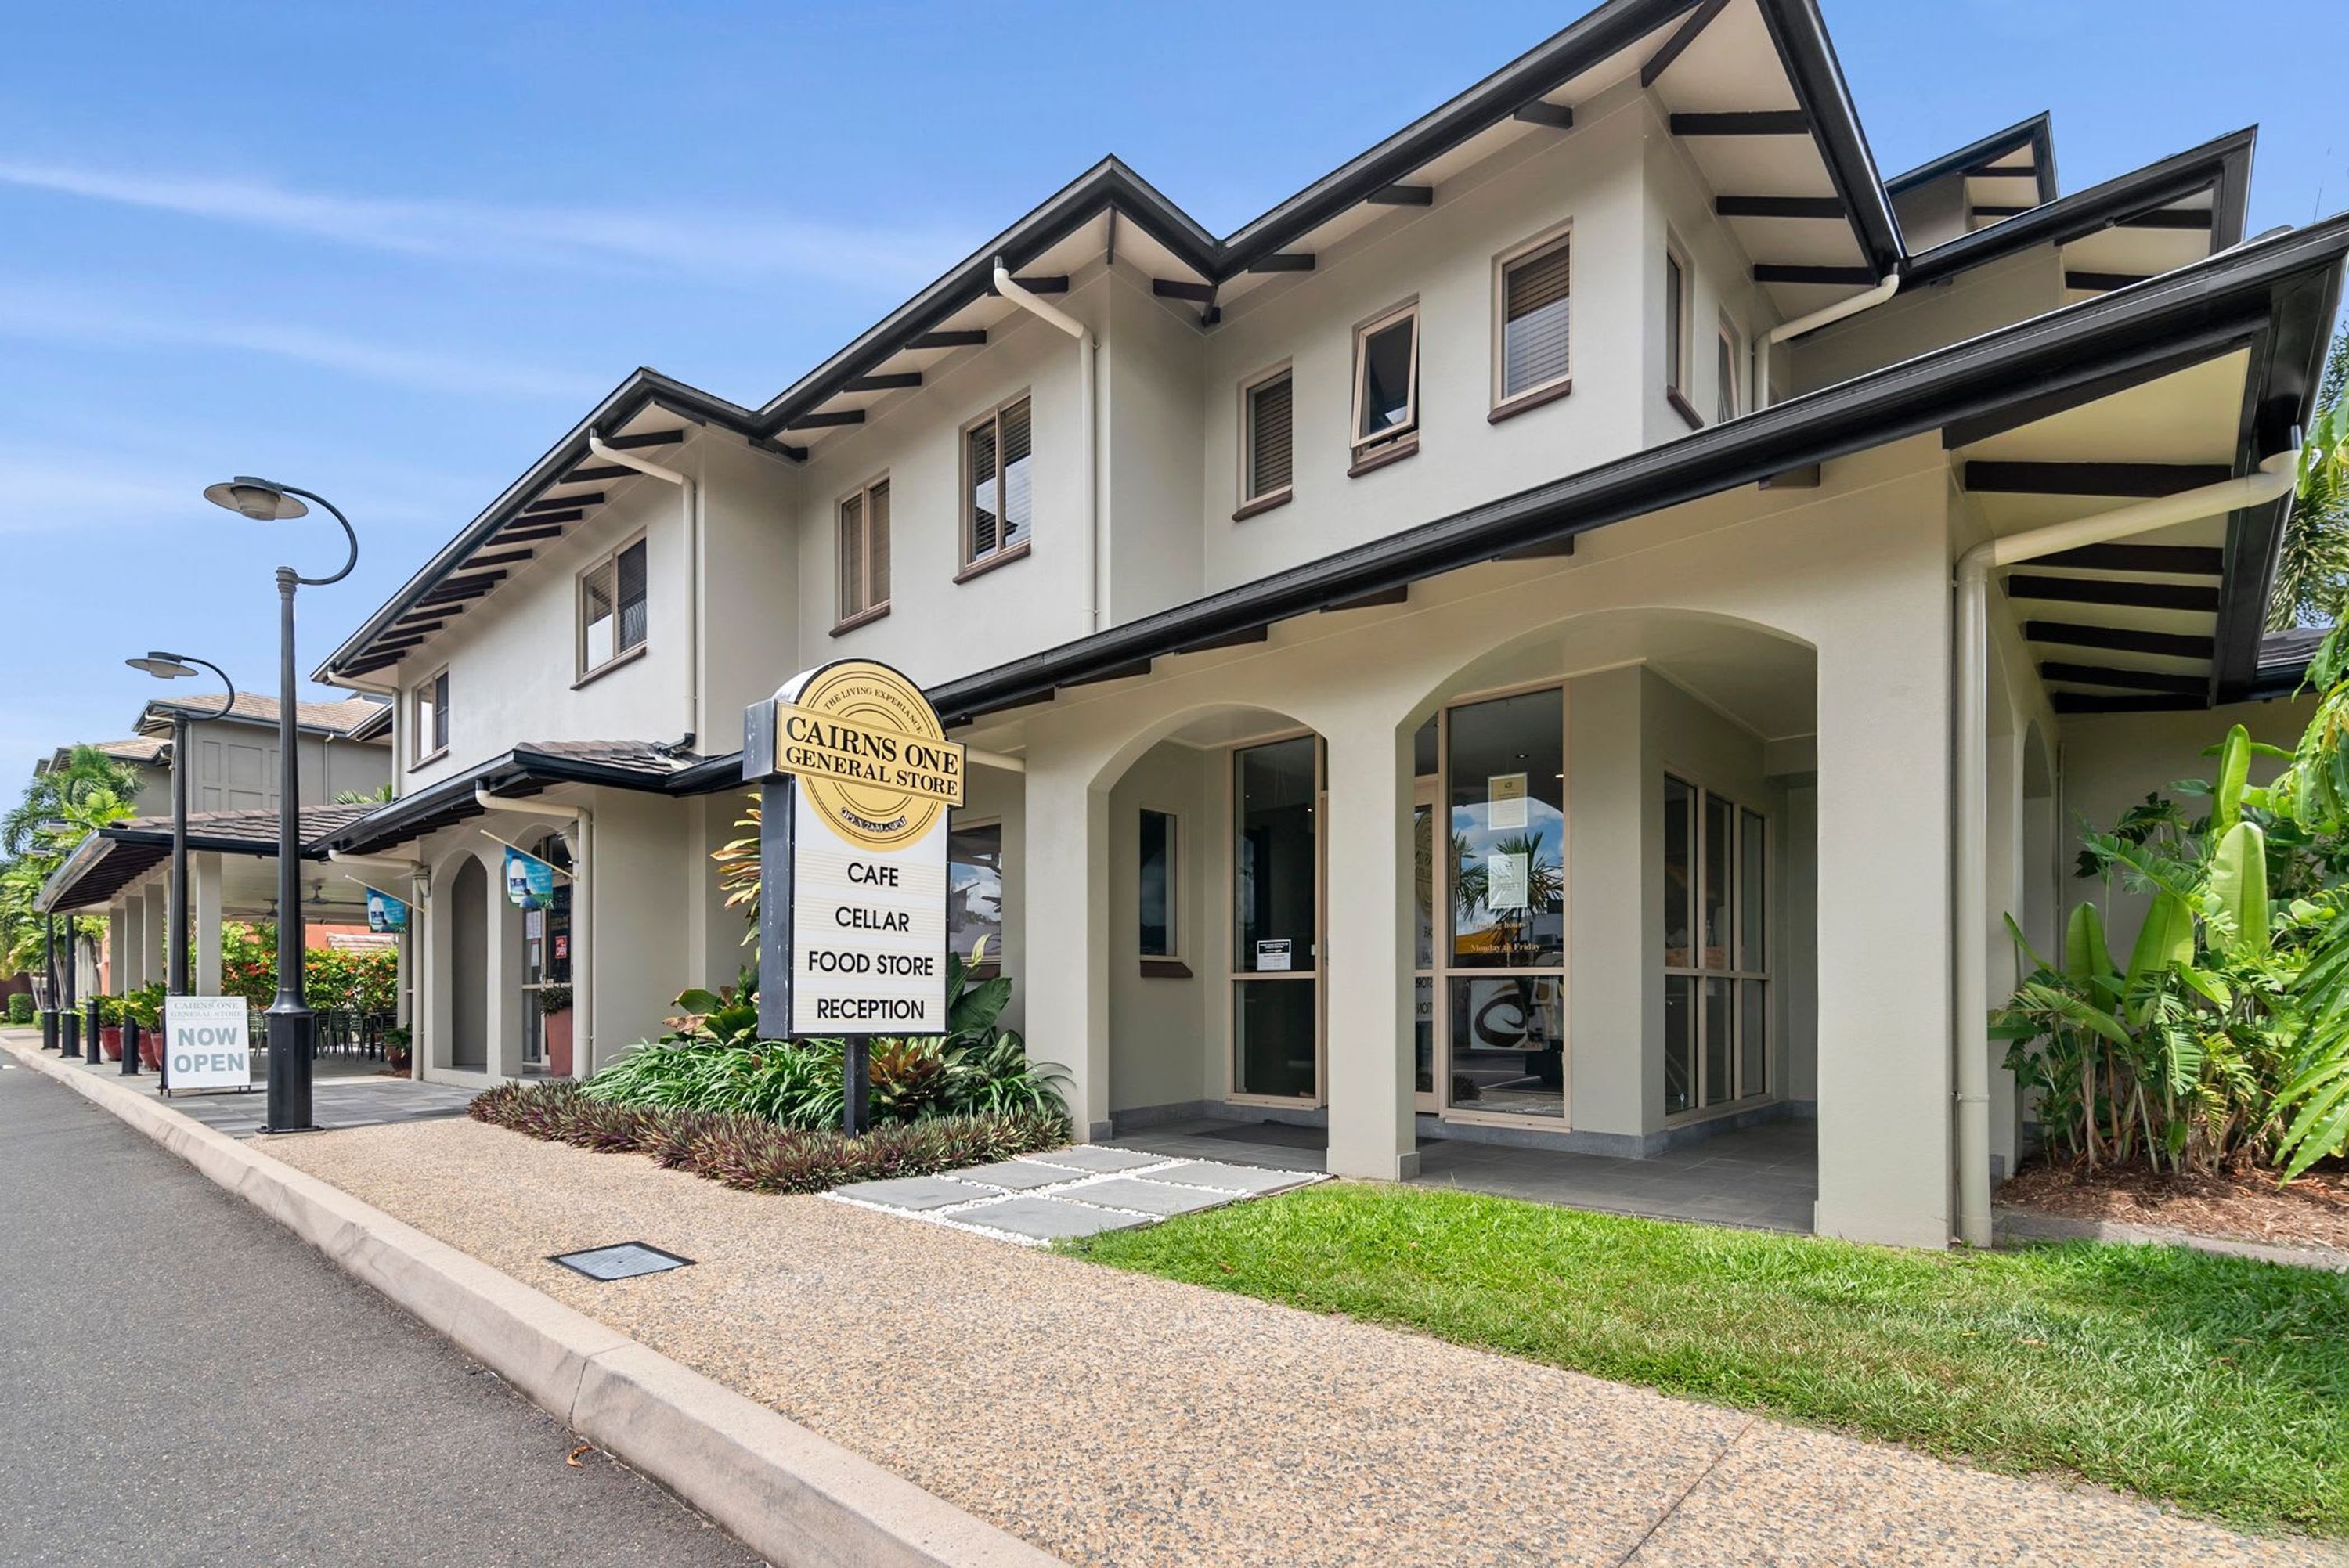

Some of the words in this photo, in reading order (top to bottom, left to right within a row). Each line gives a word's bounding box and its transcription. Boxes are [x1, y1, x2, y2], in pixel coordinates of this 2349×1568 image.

[824, 694, 841, 710] THE
[841, 687, 872, 699] LIVING
[786, 716, 897, 762] CAIRNS
[905, 744, 958, 775] ONE
[786, 747, 891, 783] GENERAL
[897, 770, 958, 795] STORE
[847, 862, 899, 887] CAFE
[835, 906, 910, 932] CELLAR
[1470, 944, 1500, 953] Monday
[1514, 943, 1540, 952] Friday
[809, 950, 870, 973] FOOD
[877, 954, 933, 976] STORE
[817, 998, 925, 1019] RECEPTION
[178, 1027, 237, 1046] NOW
[174, 1053, 244, 1073] OPEN
